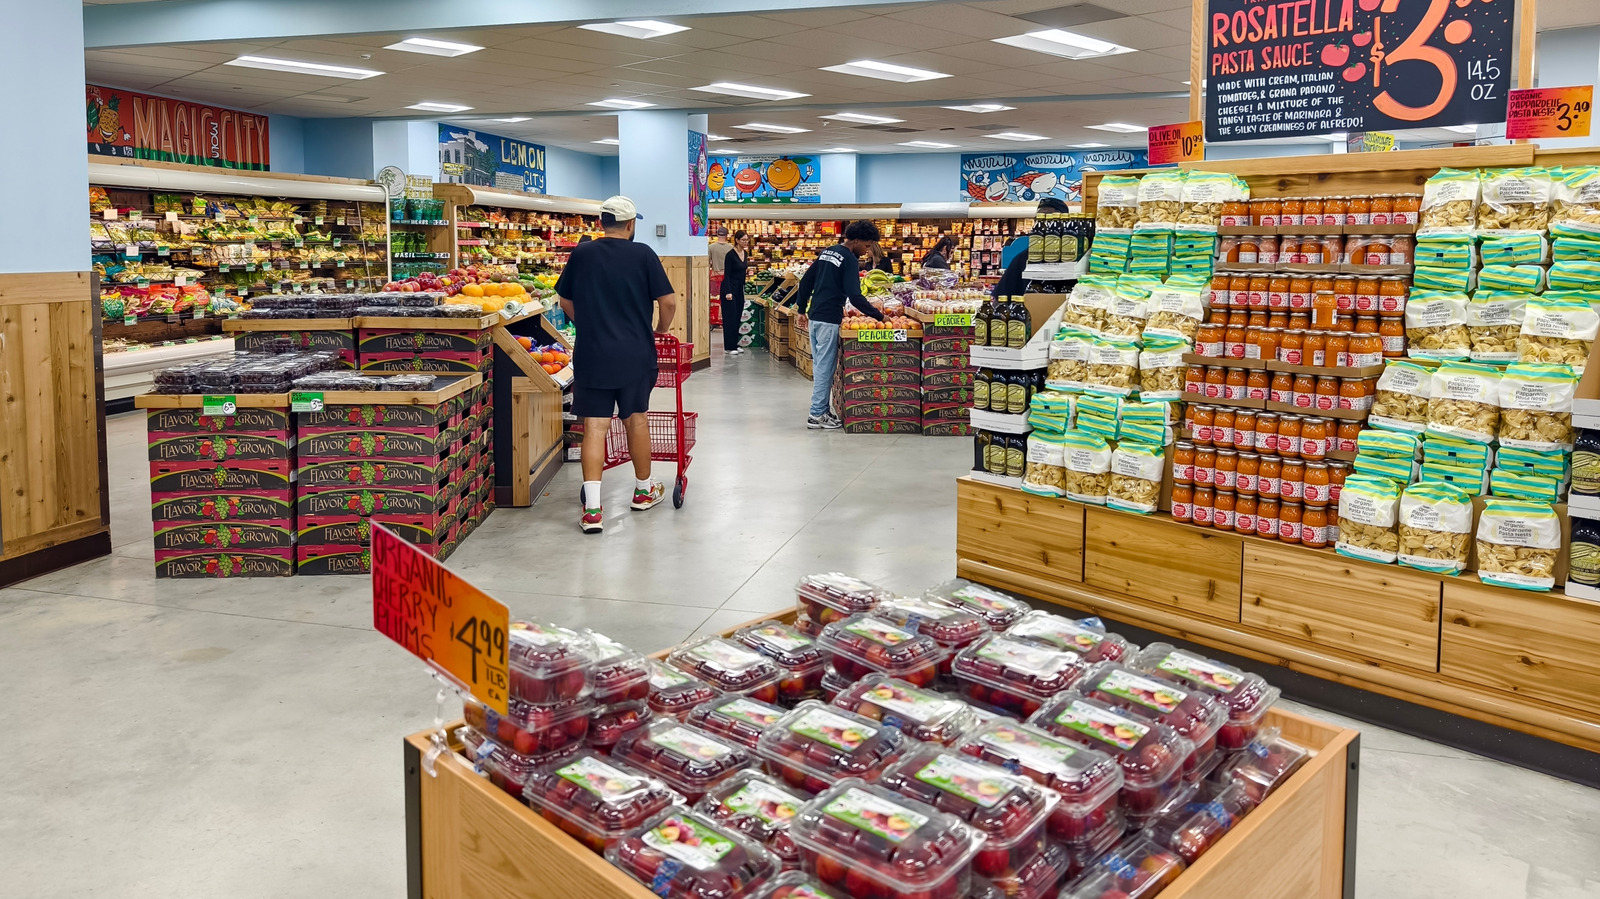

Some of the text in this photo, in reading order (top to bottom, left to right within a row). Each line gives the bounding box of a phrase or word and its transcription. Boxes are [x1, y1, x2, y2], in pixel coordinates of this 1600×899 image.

[1212, 0, 1354, 48] ROSATELLA
[1212, 42, 1314, 76] PASTA SAUCE
[1467, 58, 1500, 80] 14.5
[1217, 72, 1334, 91] MADE WITH CREAM, ITALIAN
[1269, 88, 1297, 99] GRANA
[1300, 84, 1336, 96] PADANO
[1470, 83, 1496, 100] OZ
[1510, 92, 1542, 101] ORGANIC
[1218, 96, 1344, 116] CHEESE! A MIXTURE OF THE
[1508, 108, 1556, 118] PASTA NESTS
[1218, 107, 1342, 126] TANGY TASTE OF MARINARA &
[133, 96, 214, 167] MAGIC
[1218, 116, 1364, 136] THE SILKY CREAMINESS OF ALFREDO!
[220, 109, 266, 172] CITY
[1149, 129, 1182, 142] OLIVE OIL
[500, 139, 544, 172] LEMON
[964, 154, 1014, 179] merrily
[1024, 154, 1075, 172] merrily
[1084, 152, 1140, 171] merrily
[522, 170, 544, 189] CITY
[936, 316, 966, 326] PEACHES
[311, 336, 344, 347] GROWN
[385, 336, 453, 349] FLAVOR GROWN
[384, 362, 450, 371] FLAVOR GROWN
[159, 413, 275, 428] FLAVOR GROWN
[310, 410, 422, 424] FLAVOR GROWN
[160, 443, 276, 458] FLAVOR GROWN
[310, 440, 423, 454] FLAVOR GROWN
[180, 473, 260, 488] FLAVOR GROWN
[310, 468, 422, 482] FLAVOR GROWN
[163, 502, 278, 518] FLAVOR GROWN
[310, 498, 422, 512] FLAVOR GROWN
[166, 531, 280, 546] FLAVOR GROWN
[324, 528, 356, 540] FLAVOR
[167, 560, 280, 576] FLAVOR GROWN
[328, 558, 360, 571] FLAVOR
[374, 530, 453, 608] ORGANIC
[372, 566, 438, 632] CHERRY
[376, 600, 436, 661] PLUMS
